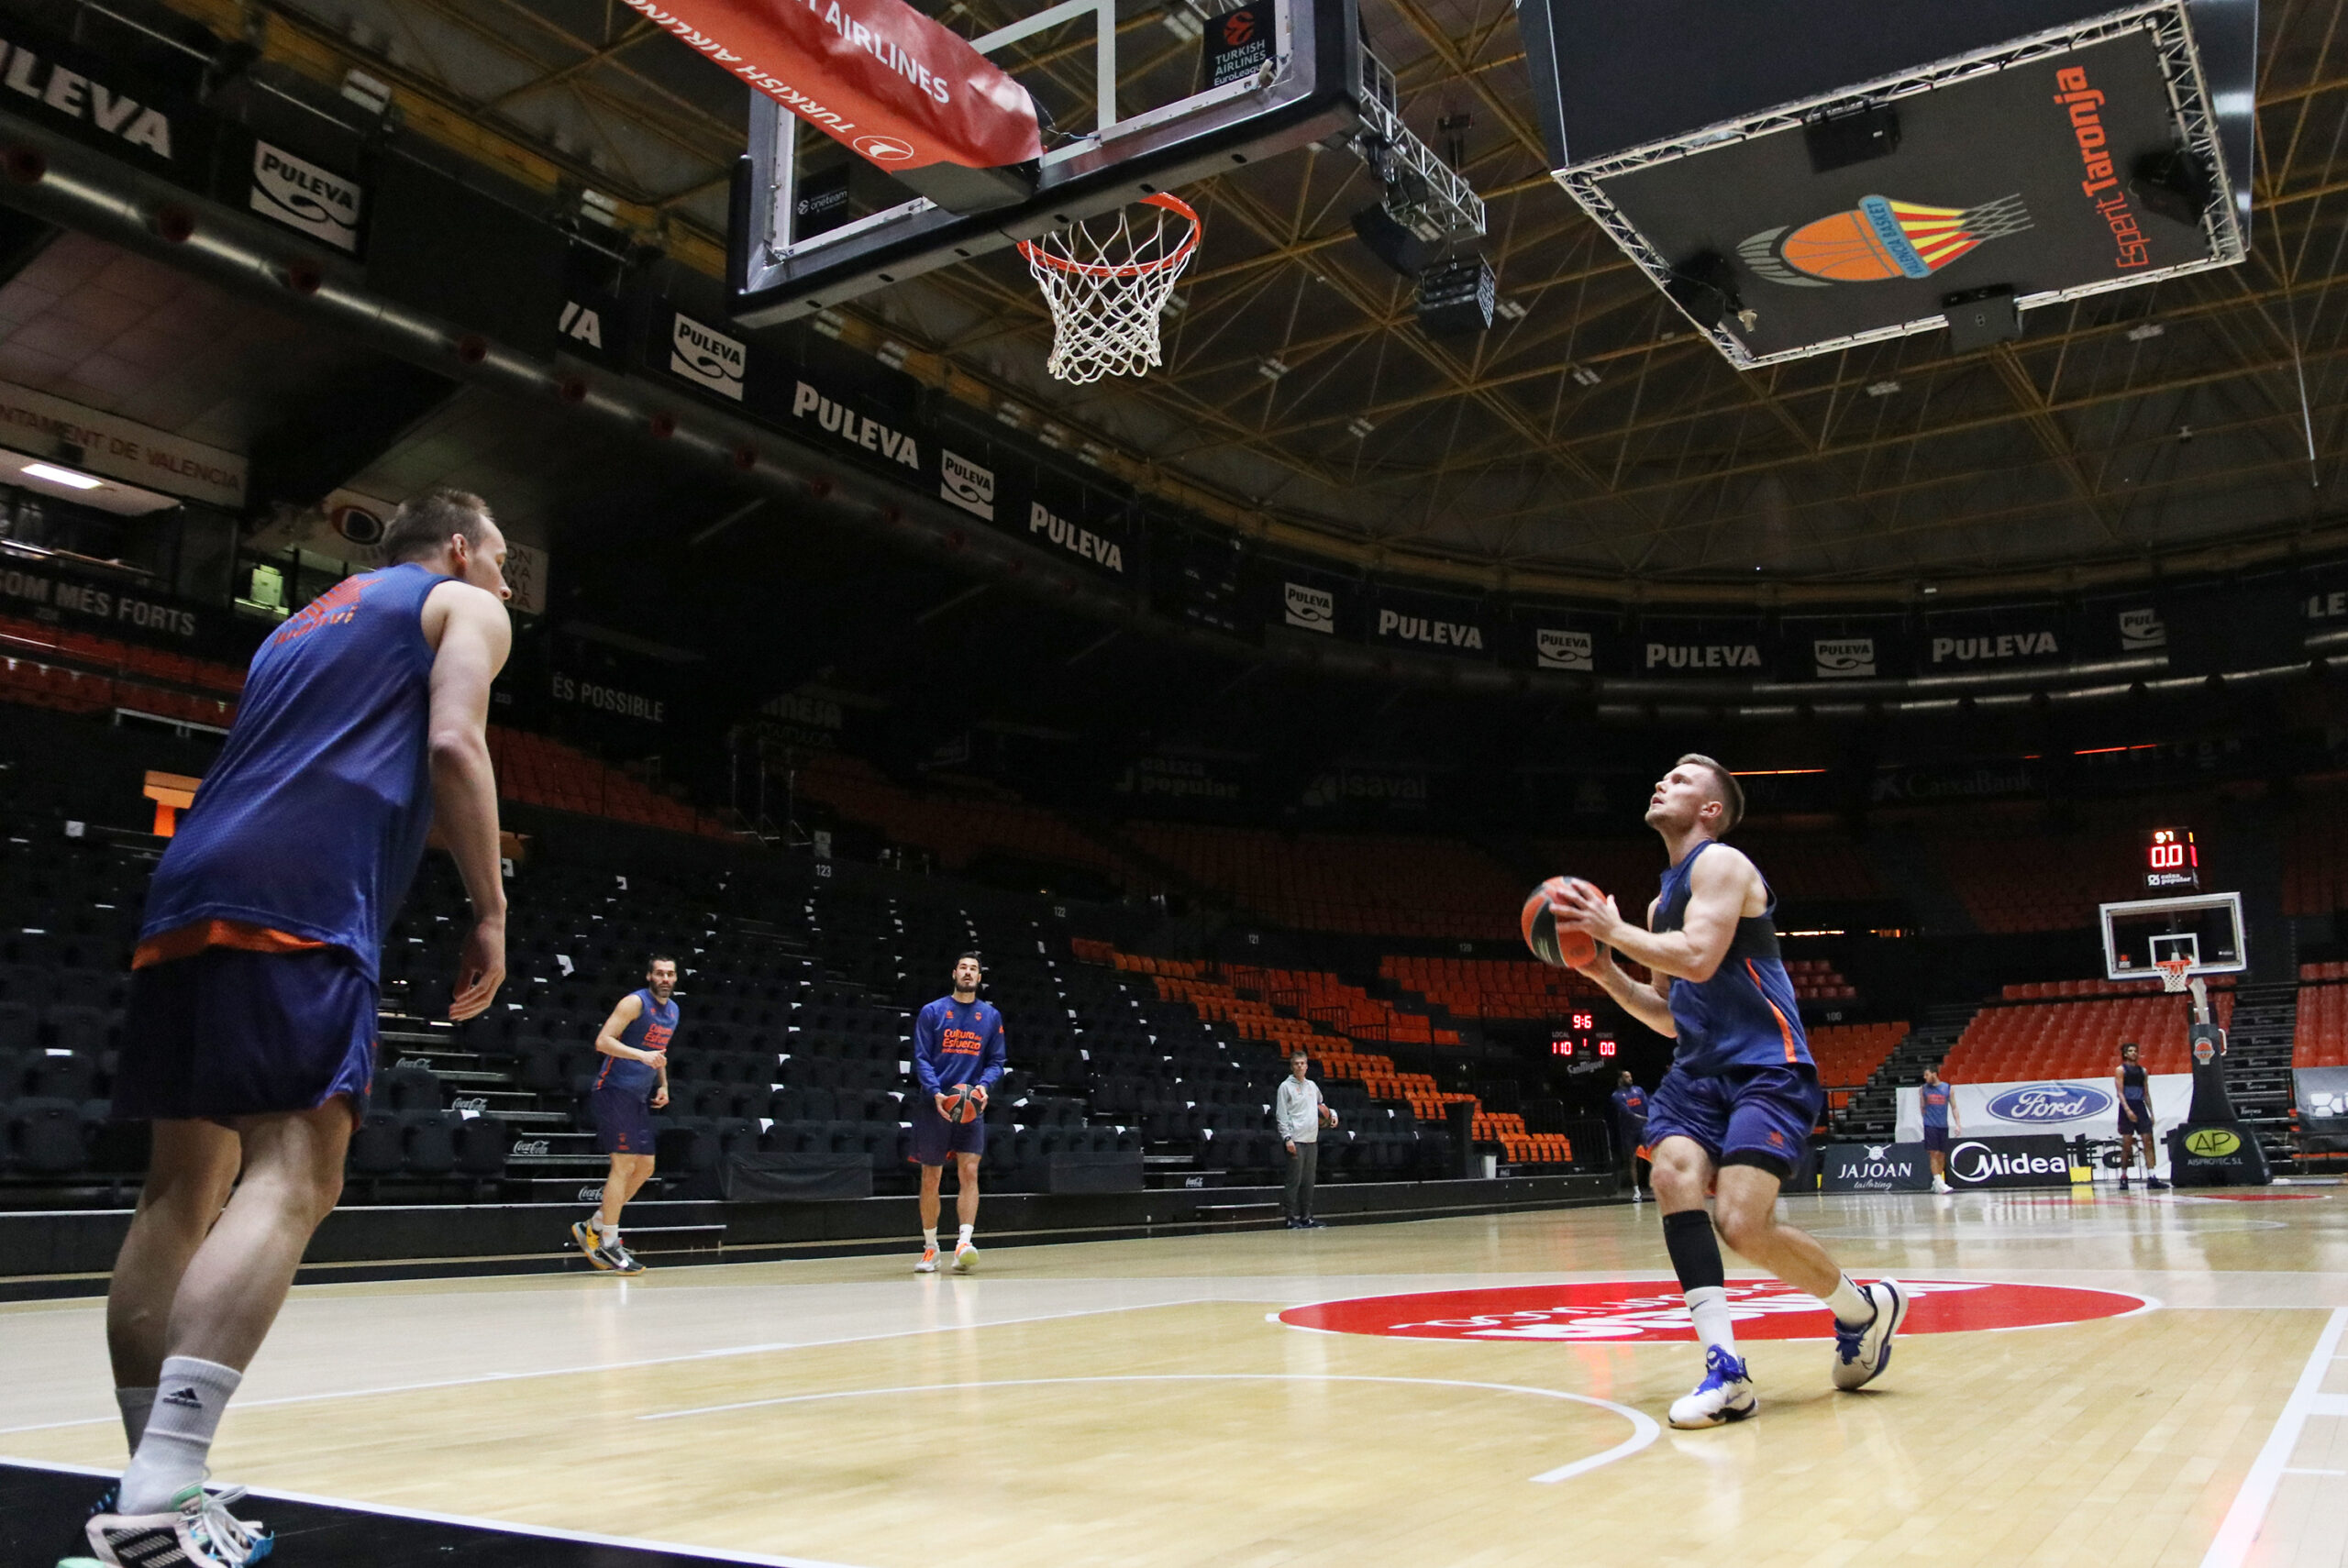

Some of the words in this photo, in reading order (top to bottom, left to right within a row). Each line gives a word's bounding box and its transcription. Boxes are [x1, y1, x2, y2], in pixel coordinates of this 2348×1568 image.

[825, 1, 949, 104] AIRLINES
[1214, 50, 1267, 76] AIRLINES
[1215, 39, 1265, 65] TURKISH
[1213, 64, 1263, 86] EuroLeagu
[736, 65, 856, 133] TURKISH
[2053, 65, 2118, 197] Taronja
[261, 151, 354, 210] PULEVA
[810, 190, 848, 210] oneteam
[1866, 203, 1898, 238] BASKET
[2095, 191, 2151, 268] Esperit
[1888, 238, 1923, 276] VALENCIA
[679, 321, 741, 366] PULEVA
[792, 380, 920, 470] PULEVA
[146, 446, 240, 491] VALENCIA
[945, 457, 991, 491] PULEVA
[1029, 500, 1123, 573] PULEVA
[1288, 587, 1330, 610] PULEVA
[117, 597, 196, 636] FORTS
[1379, 609, 1483, 650] PULEVA
[1541, 632, 1589, 649] PULEVA
[1818, 644, 1870, 657] PULEVA
[1933, 632, 2059, 663] PULEVA
[1645, 643, 1762, 668] PULEVA
[581, 680, 664, 724] POSSIBLE
[815, 864, 831, 878] 123
[943, 1037, 981, 1050] Esfuerzo
[944, 1028, 975, 1039] Cultura
[1600, 1042, 1615, 1055] 00
[2010, 1090, 2088, 1118] Ford
[513, 1140, 550, 1154] Coca-Cola
[2194, 1132, 2232, 1152] AP
[1837, 1162, 1912, 1178] JAJOAN
[1969, 1153, 2066, 1176] Midea
[1854, 1178, 1892, 1190] tailoring
